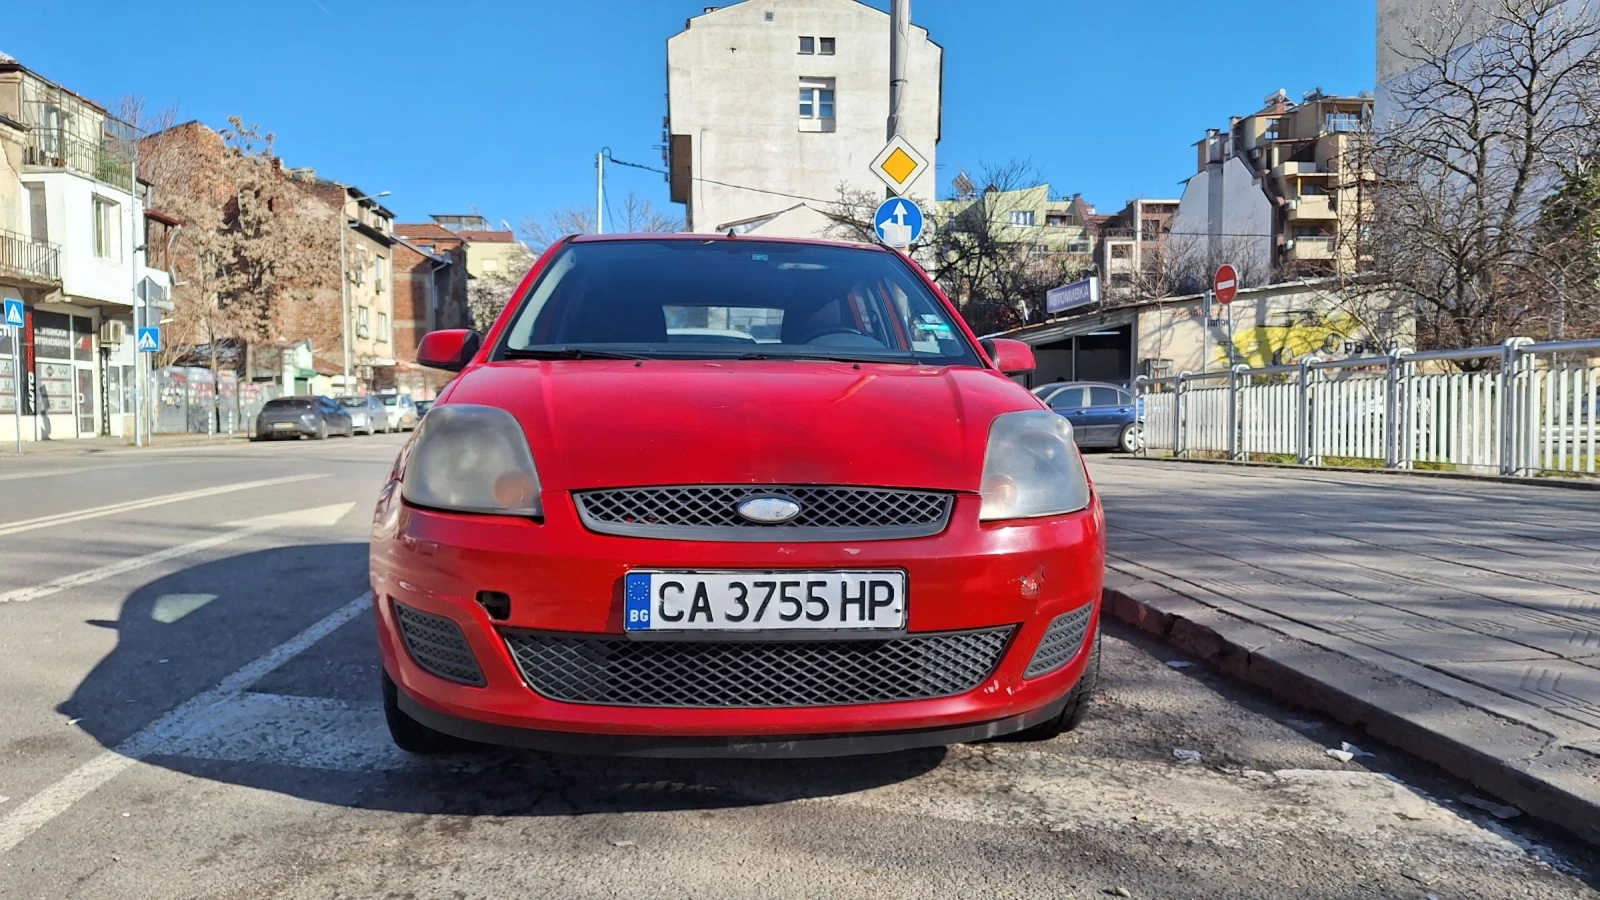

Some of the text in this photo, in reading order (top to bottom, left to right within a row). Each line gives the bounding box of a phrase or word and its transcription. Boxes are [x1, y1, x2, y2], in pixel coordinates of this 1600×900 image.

[1049, 284, 1089, 306] АВТОМИВКА
[34, 336, 70, 347] ВТОМОБИЛИ
[658, 580, 895, 623] CA 3755 HP
[629, 609, 649, 623] BG
